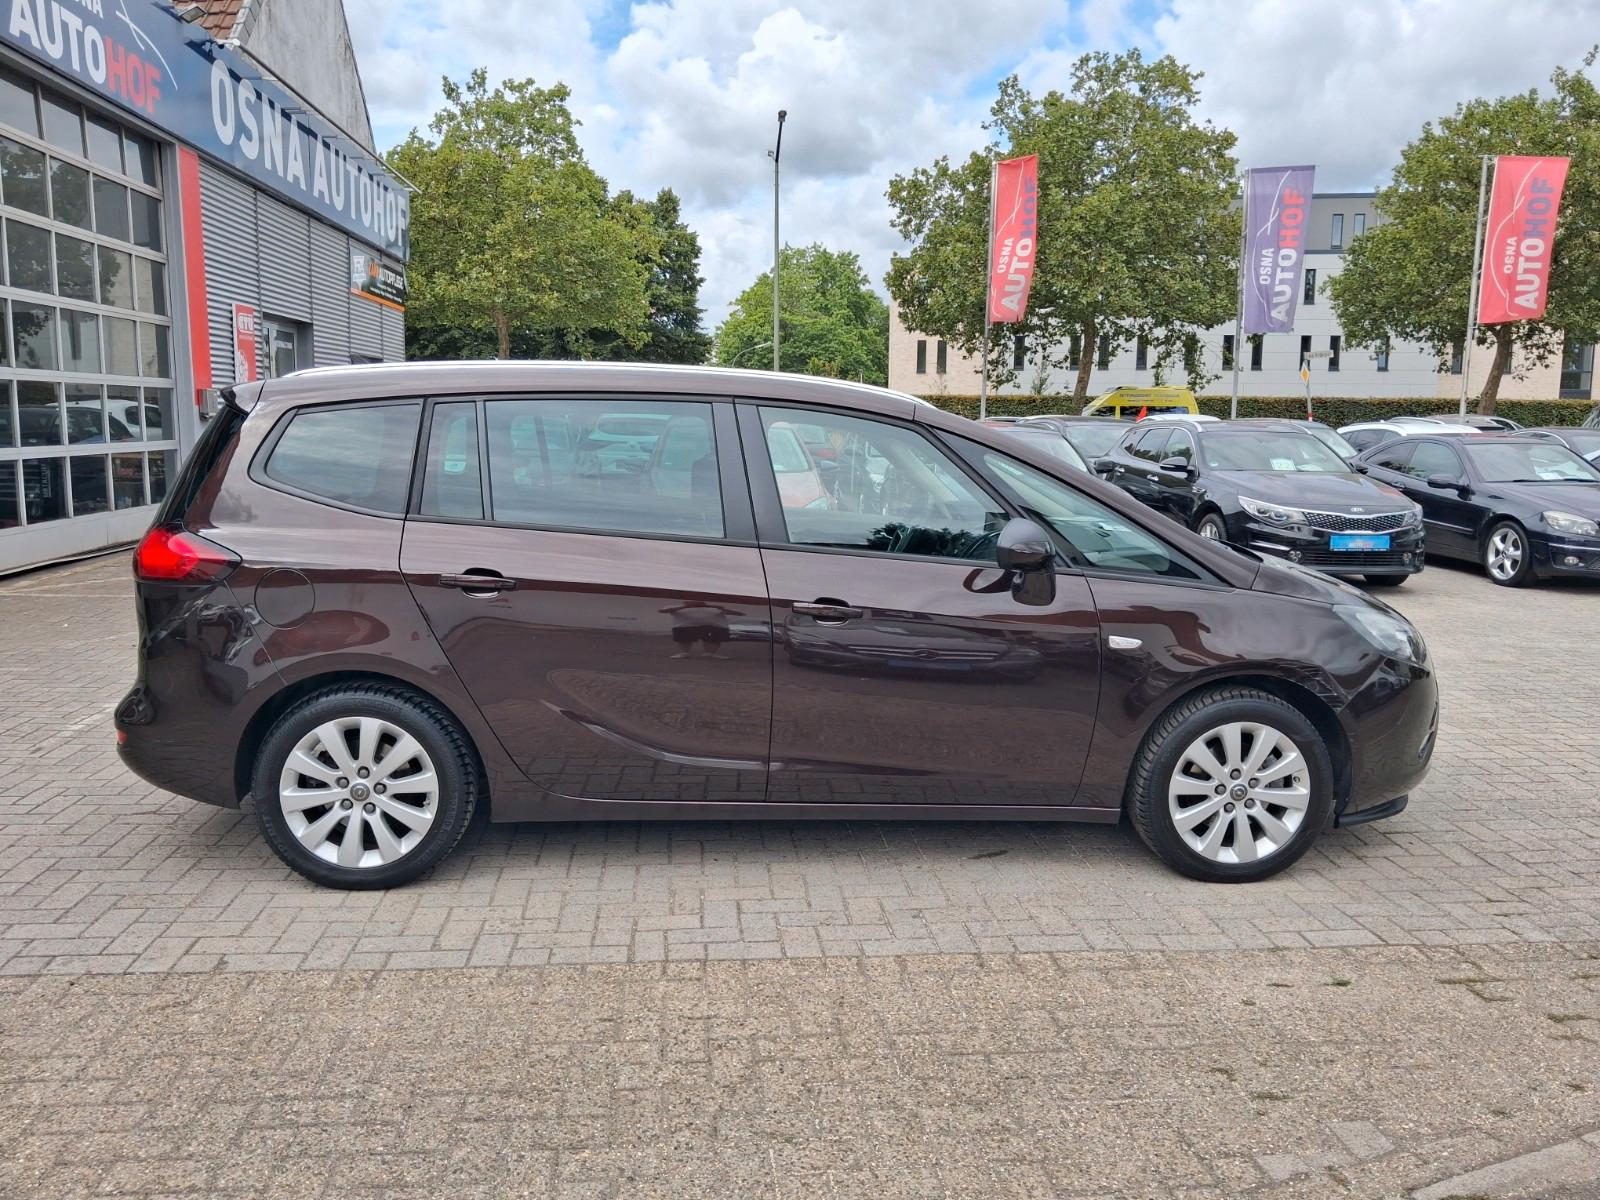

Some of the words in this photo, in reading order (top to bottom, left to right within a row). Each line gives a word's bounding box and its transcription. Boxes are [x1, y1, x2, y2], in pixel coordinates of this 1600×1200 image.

[9, 0, 161, 114] AUTOHOF
[210, 59, 307, 192] OSNA
[313, 133, 407, 247] AUTOHOF
[997, 238, 1015, 273] OSNA
[1259, 248, 1275, 285] OSNA
[1270, 187, 1306, 323] AUTOHOF
[1503, 236, 1518, 274] OSNA
[1514, 177, 1555, 310] AUTOHOF
